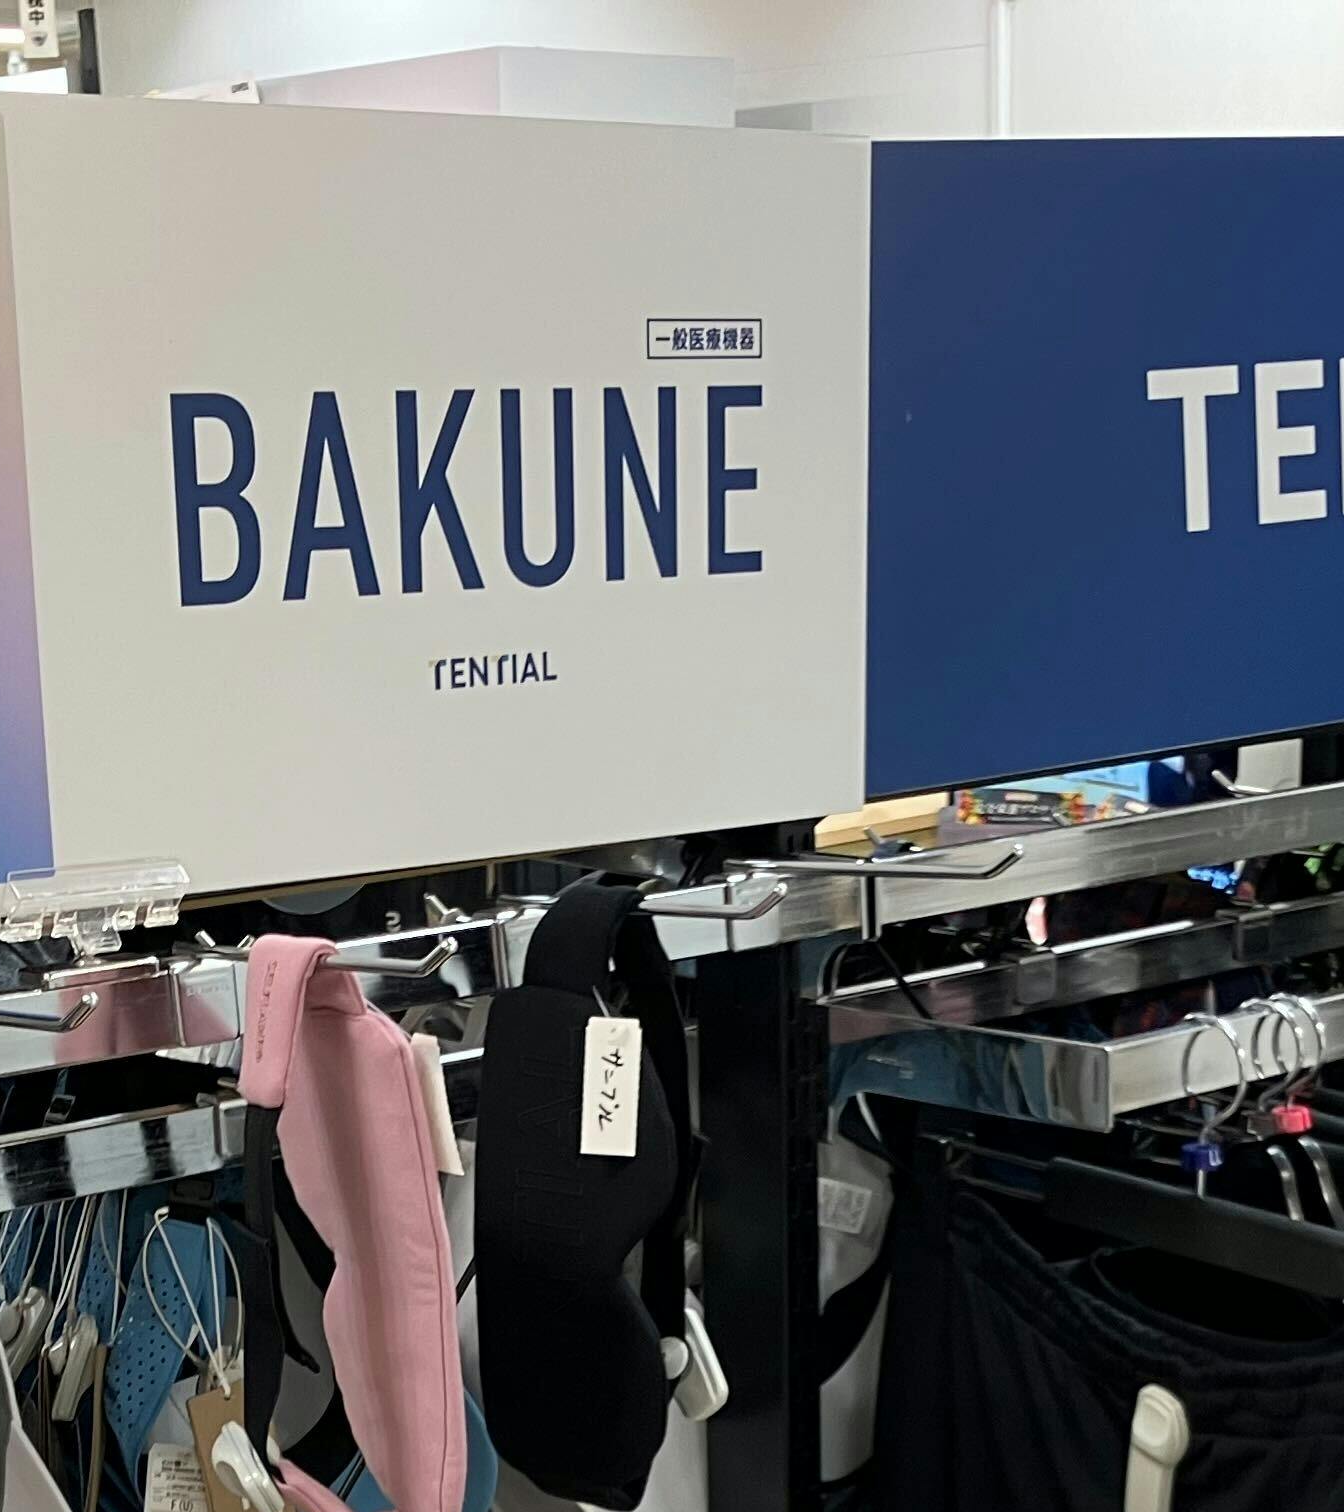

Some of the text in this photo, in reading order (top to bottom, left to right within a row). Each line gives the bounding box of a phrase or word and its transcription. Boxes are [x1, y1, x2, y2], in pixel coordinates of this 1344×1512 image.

[655, 325, 756, 353] 一般医療機器
[169, 384, 764, 608] BAKUNE
[427, 650, 559, 692] TENTIAL
